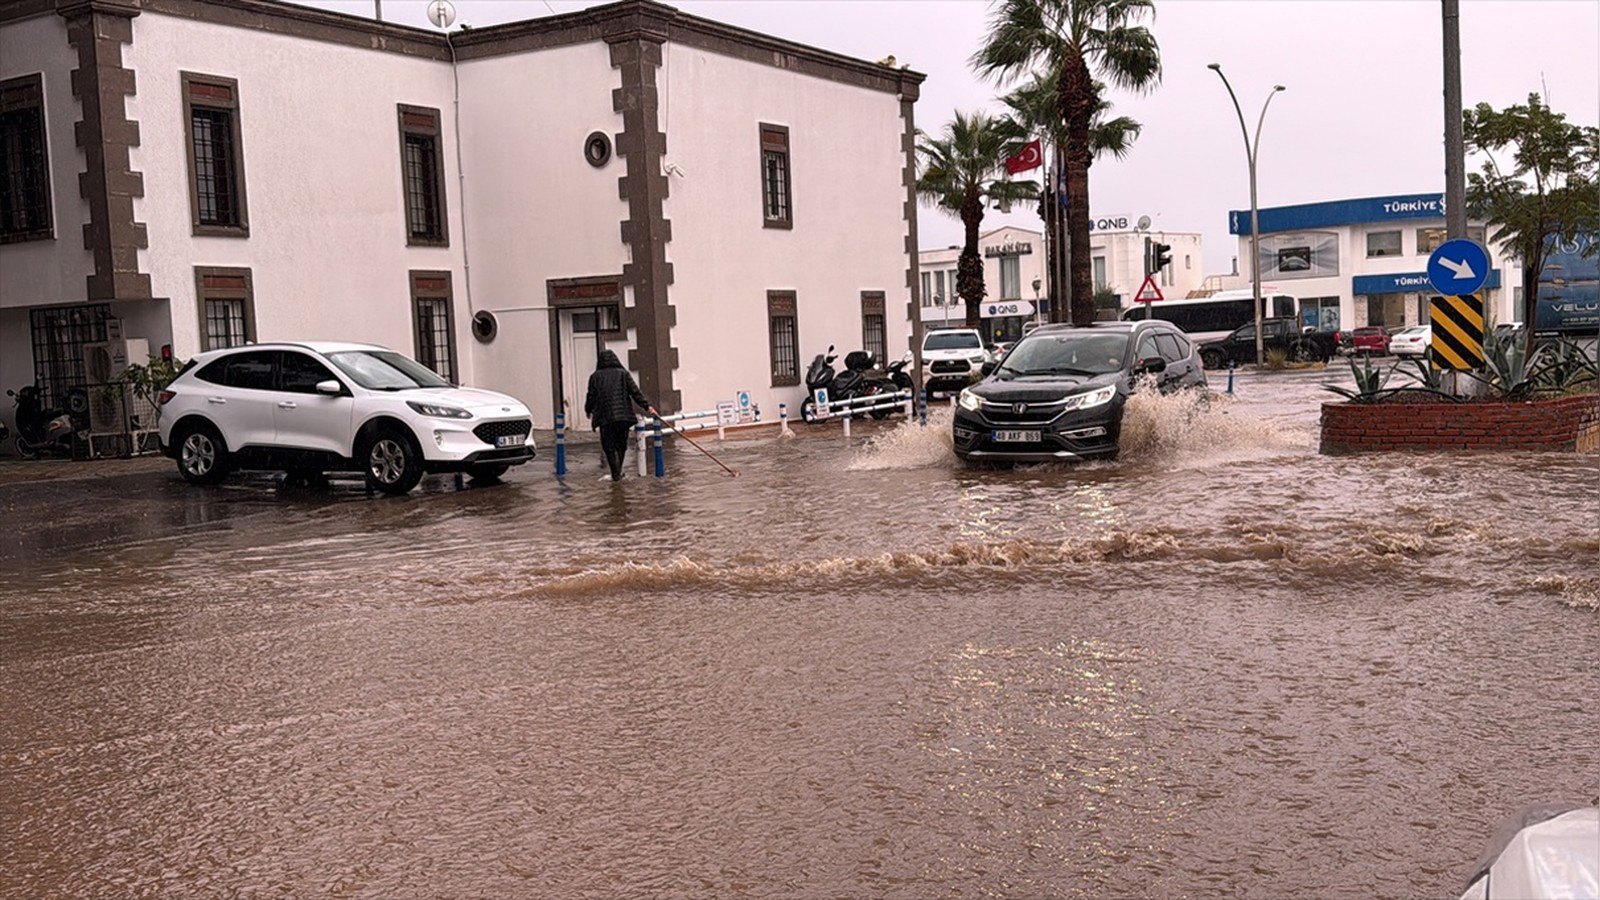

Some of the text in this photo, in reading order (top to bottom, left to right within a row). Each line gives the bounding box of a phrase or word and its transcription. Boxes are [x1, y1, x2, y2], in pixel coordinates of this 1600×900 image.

[1383, 200, 1437, 213] TÜRKİYE
[1097, 217, 1128, 230] QNB
[1394, 276, 1430, 286] TÜRKİY
[997, 304, 1019, 314] QNB
